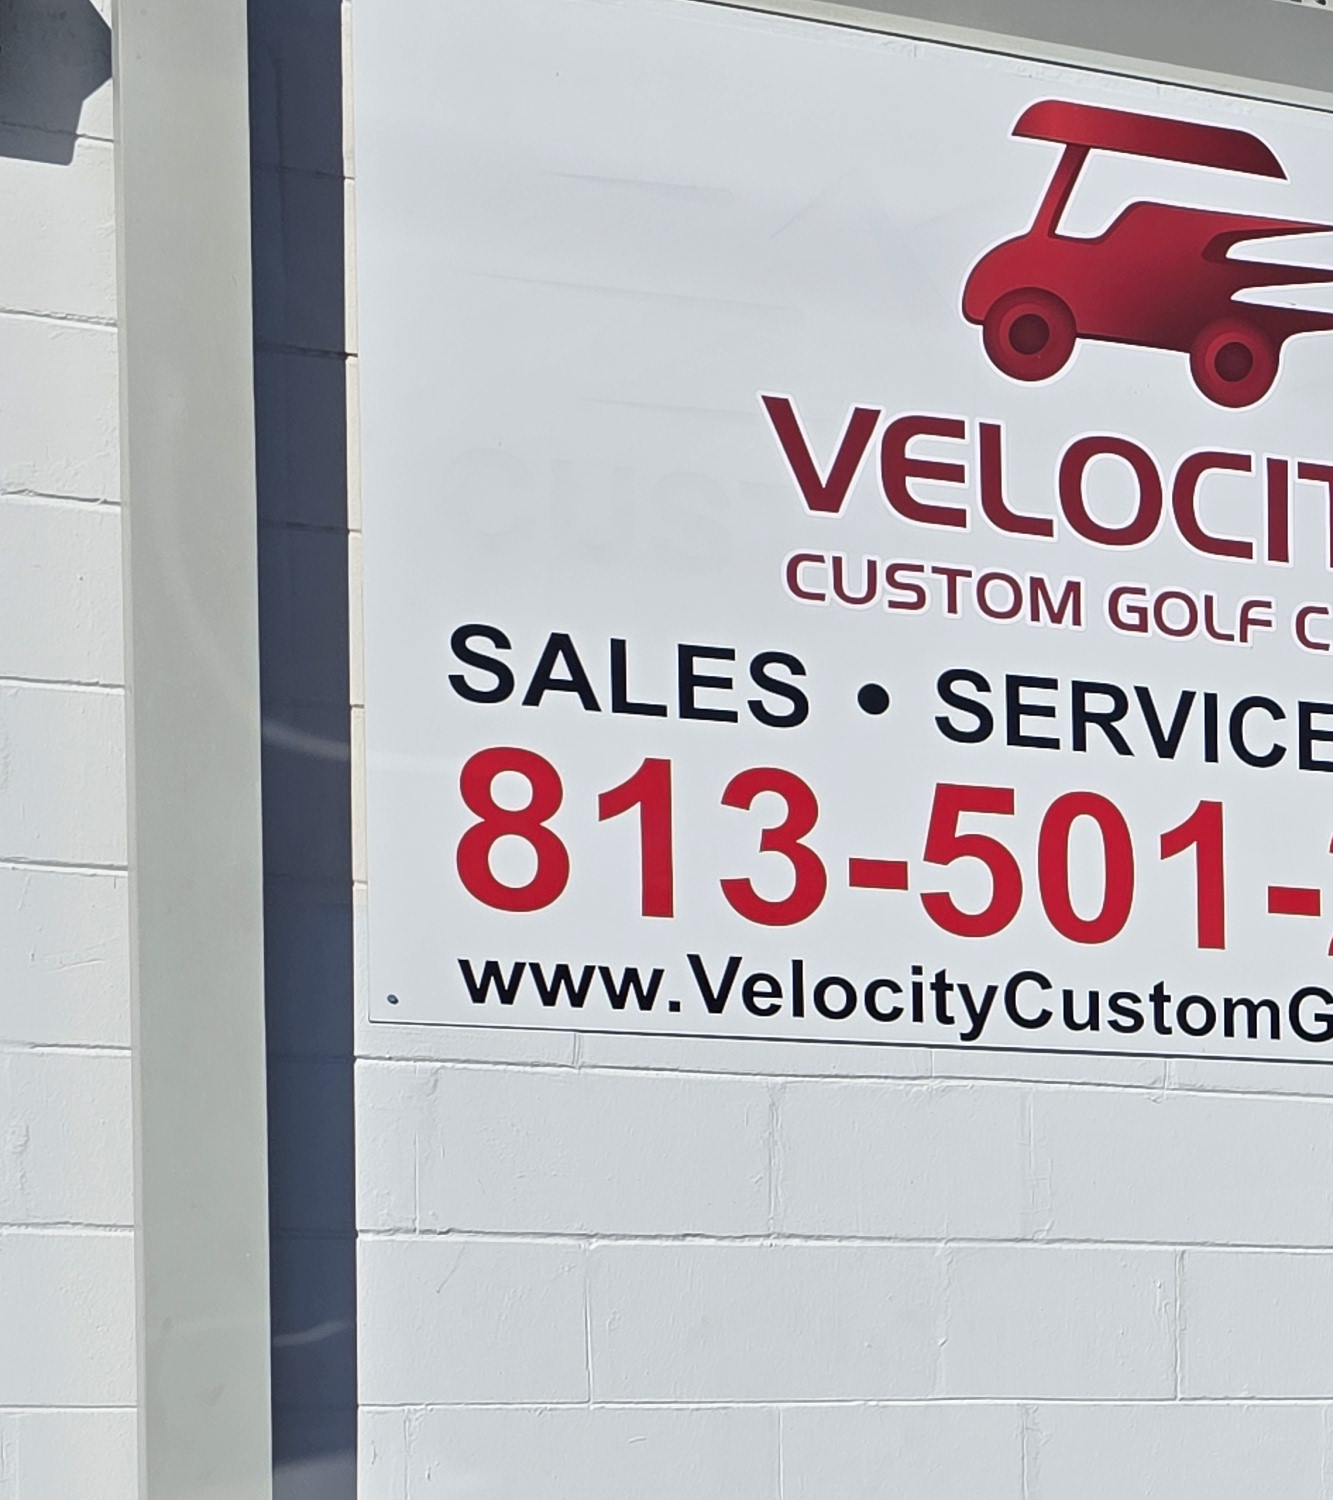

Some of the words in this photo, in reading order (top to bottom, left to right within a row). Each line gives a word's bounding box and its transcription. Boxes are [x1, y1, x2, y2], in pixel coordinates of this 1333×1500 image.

[786, 553, 1082, 627] CUSTOM
[1108, 586, 1273, 644] GOLF
[447, 623, 810, 729] SALES
